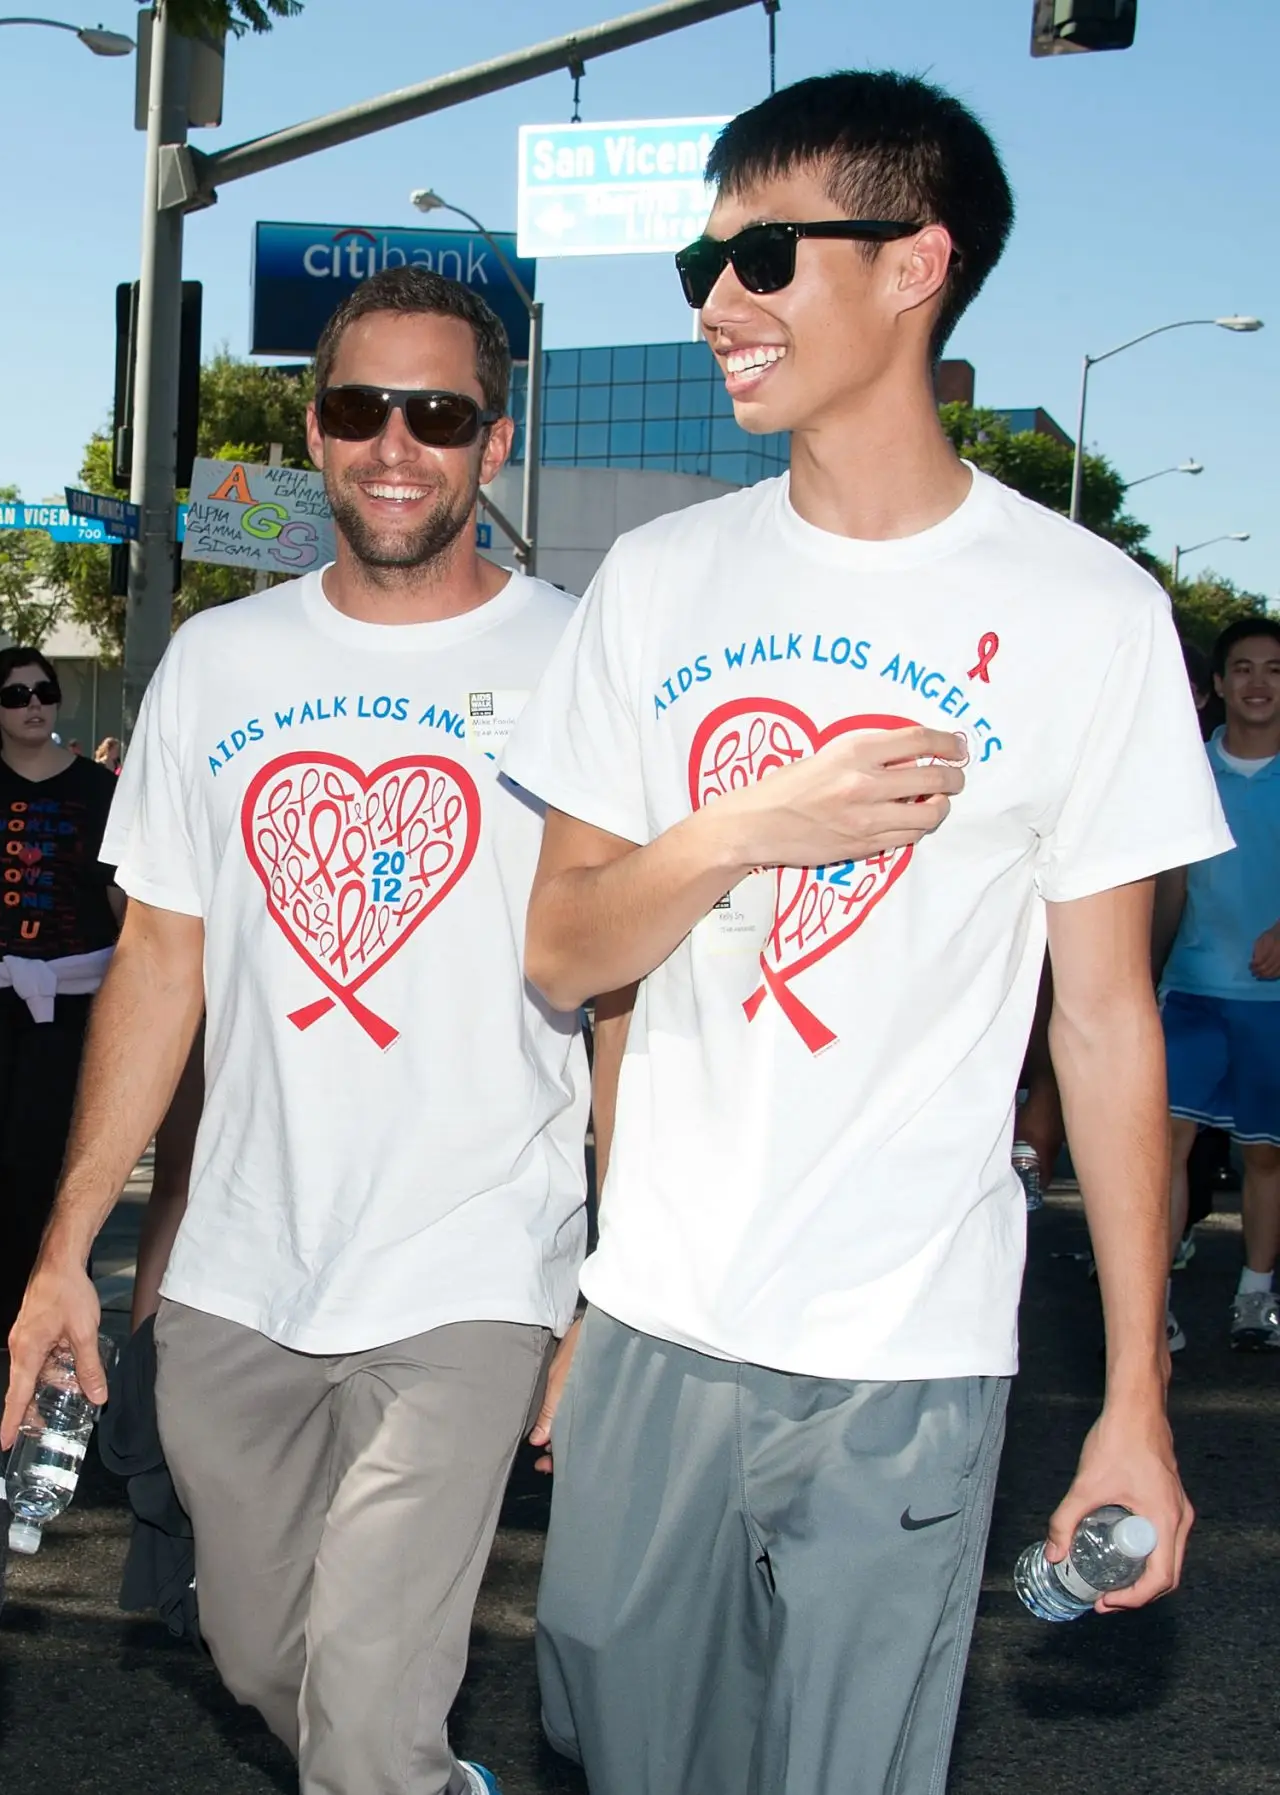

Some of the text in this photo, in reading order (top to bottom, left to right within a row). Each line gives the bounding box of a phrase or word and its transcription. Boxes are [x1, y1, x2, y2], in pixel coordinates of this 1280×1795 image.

[532, 131, 713, 180] San Vicent
[302, 235, 489, 285] citibank
[265, 468, 309, 487] ALPHA
[274, 484, 328, 504] GAMM
[187, 502, 230, 524] ALPHA
[293, 500, 332, 521] SIG
[77, 528, 102, 540] 700
[187, 520, 243, 541] GAMMA
[193, 535, 262, 560] SIGMA
[653, 654, 713, 720] AIDS
[723, 632, 803, 670] WALK
[811, 633, 873, 671] LOS
[206, 718, 266, 777] AIDS
[274, 695, 348, 731] WALK
[356, 695, 410, 722] LOS
[371, 850, 406, 876] 20
[815, 859, 856, 888] 12
[371, 876, 403, 903] 12
[20, 919, 41, 939] U
